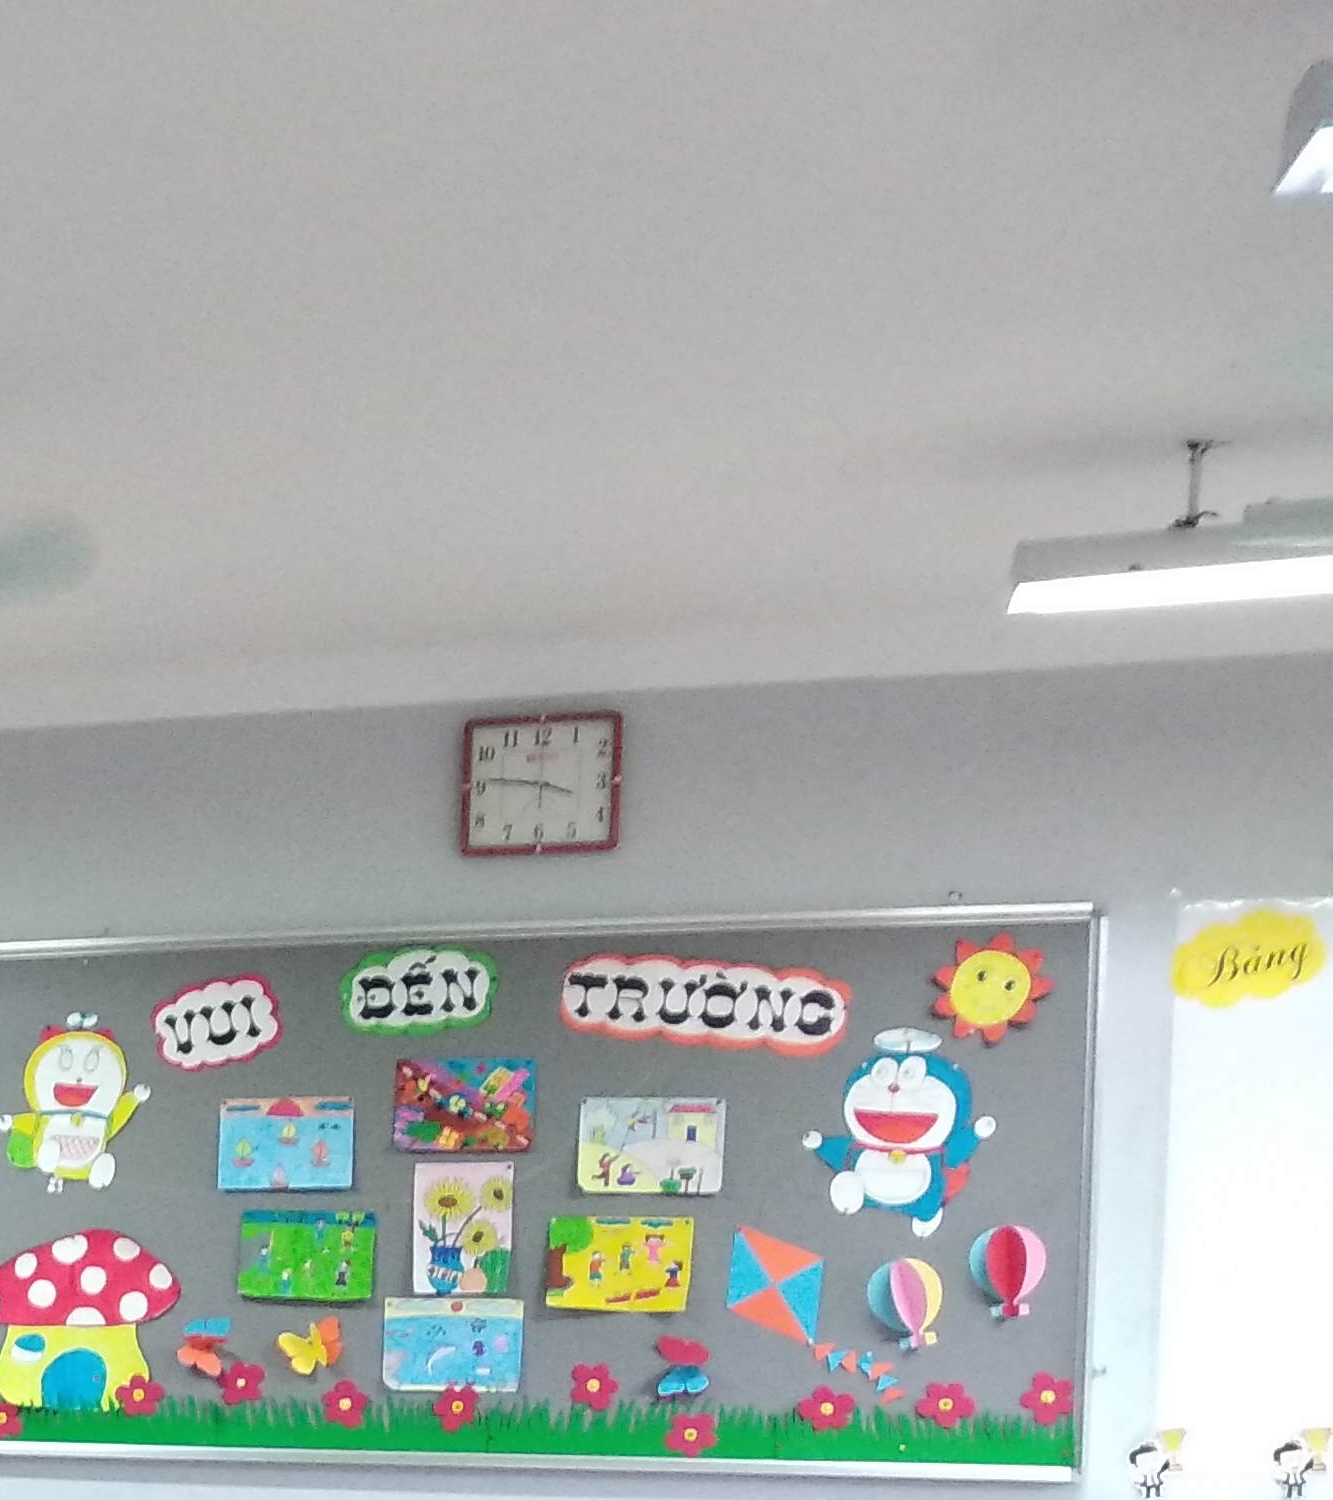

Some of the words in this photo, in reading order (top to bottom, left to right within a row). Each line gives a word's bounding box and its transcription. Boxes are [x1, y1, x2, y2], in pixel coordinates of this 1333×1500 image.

[503, 729, 519, 748] 11
[534, 728, 552, 747] 12
[573, 726, 579, 744] 1
[478, 746, 496, 762] 10
[597, 738, 608, 757] 2
[475, 780, 487, 796] 9
[596, 771, 607, 790] 3
[502, 824, 513, 841] 7
[533, 822, 544, 840] 6
[567, 821, 577, 838] 5
[164, 994, 263, 1054] VUI
[356, 955, 481, 1020] ĐẾN
[568, 970, 836, 1036] TRƯỜNG
